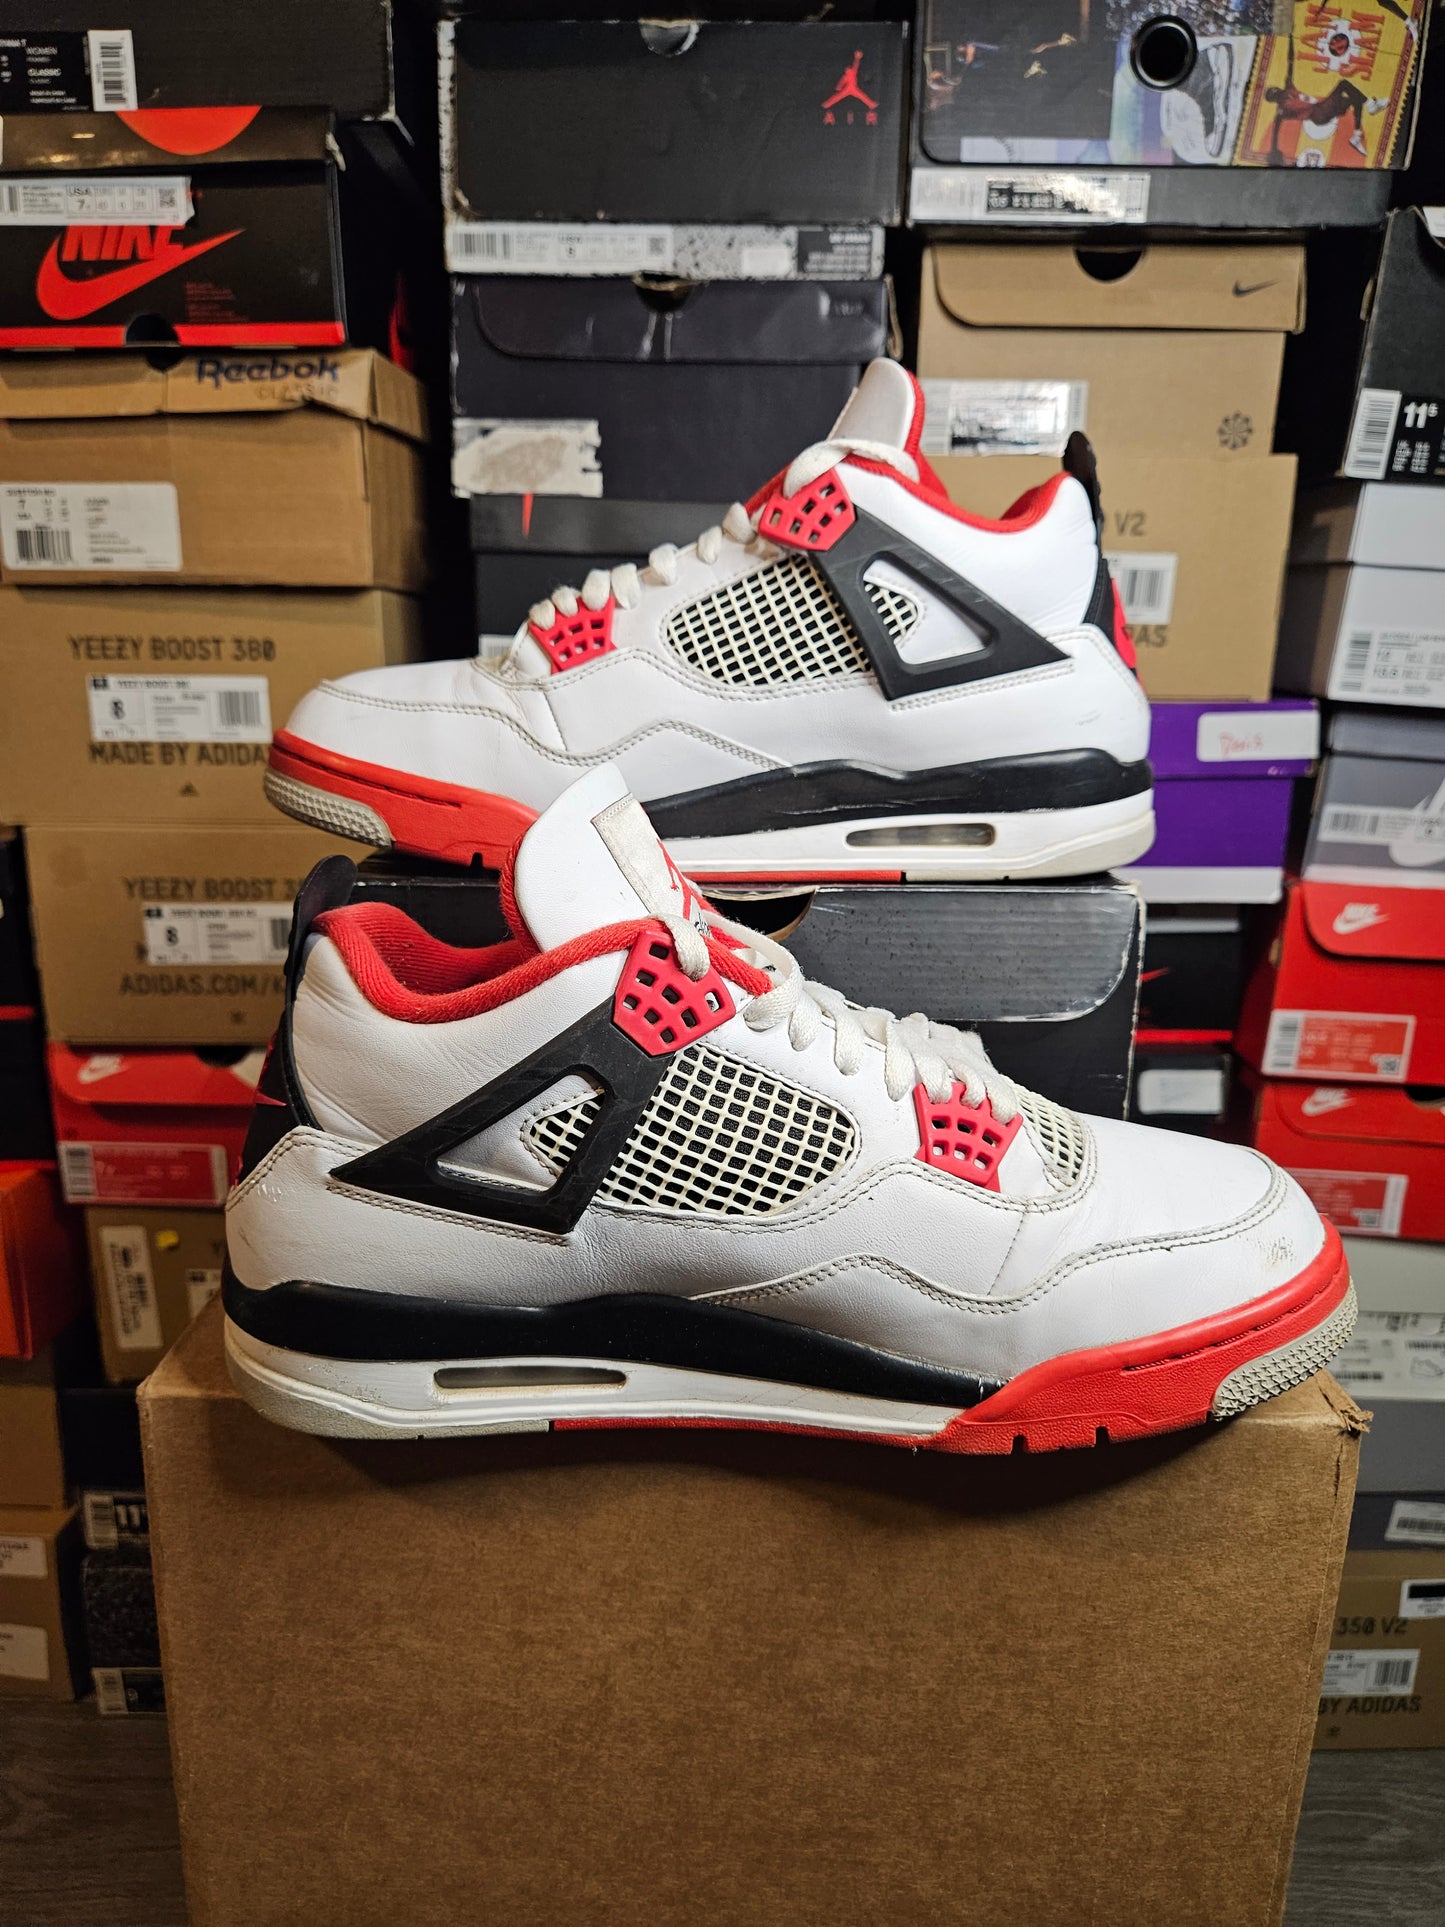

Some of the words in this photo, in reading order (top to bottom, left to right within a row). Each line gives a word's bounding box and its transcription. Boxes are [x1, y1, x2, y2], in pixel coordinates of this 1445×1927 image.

[25, 46, 58, 55] WOMEN
[1339, 10, 1385, 81] SLAM
[27, 67, 62, 77] CLASSIC
[822, 110, 879, 126] AIR
[196, 356, 340, 388] Reebok
[1114, 510, 1147, 537] V2
[69, 635, 143, 661] YEEZY
[151, 636, 224, 662] BOOST
[232, 637, 276, 662] 380
[90, 743, 154, 766] MADE
[161, 744, 189, 767] BY
[196, 744, 271, 767] ADIDA
[124, 877, 196, 899] YEEZY
[204, 878, 277, 900] BOOST
[165, 926, 179, 946] 8
[1336, 1616, 1375, 1636] 350
[1381, 1616, 1408, 1636] V2
[1346, 1695, 1422, 1715] ADIDAS
